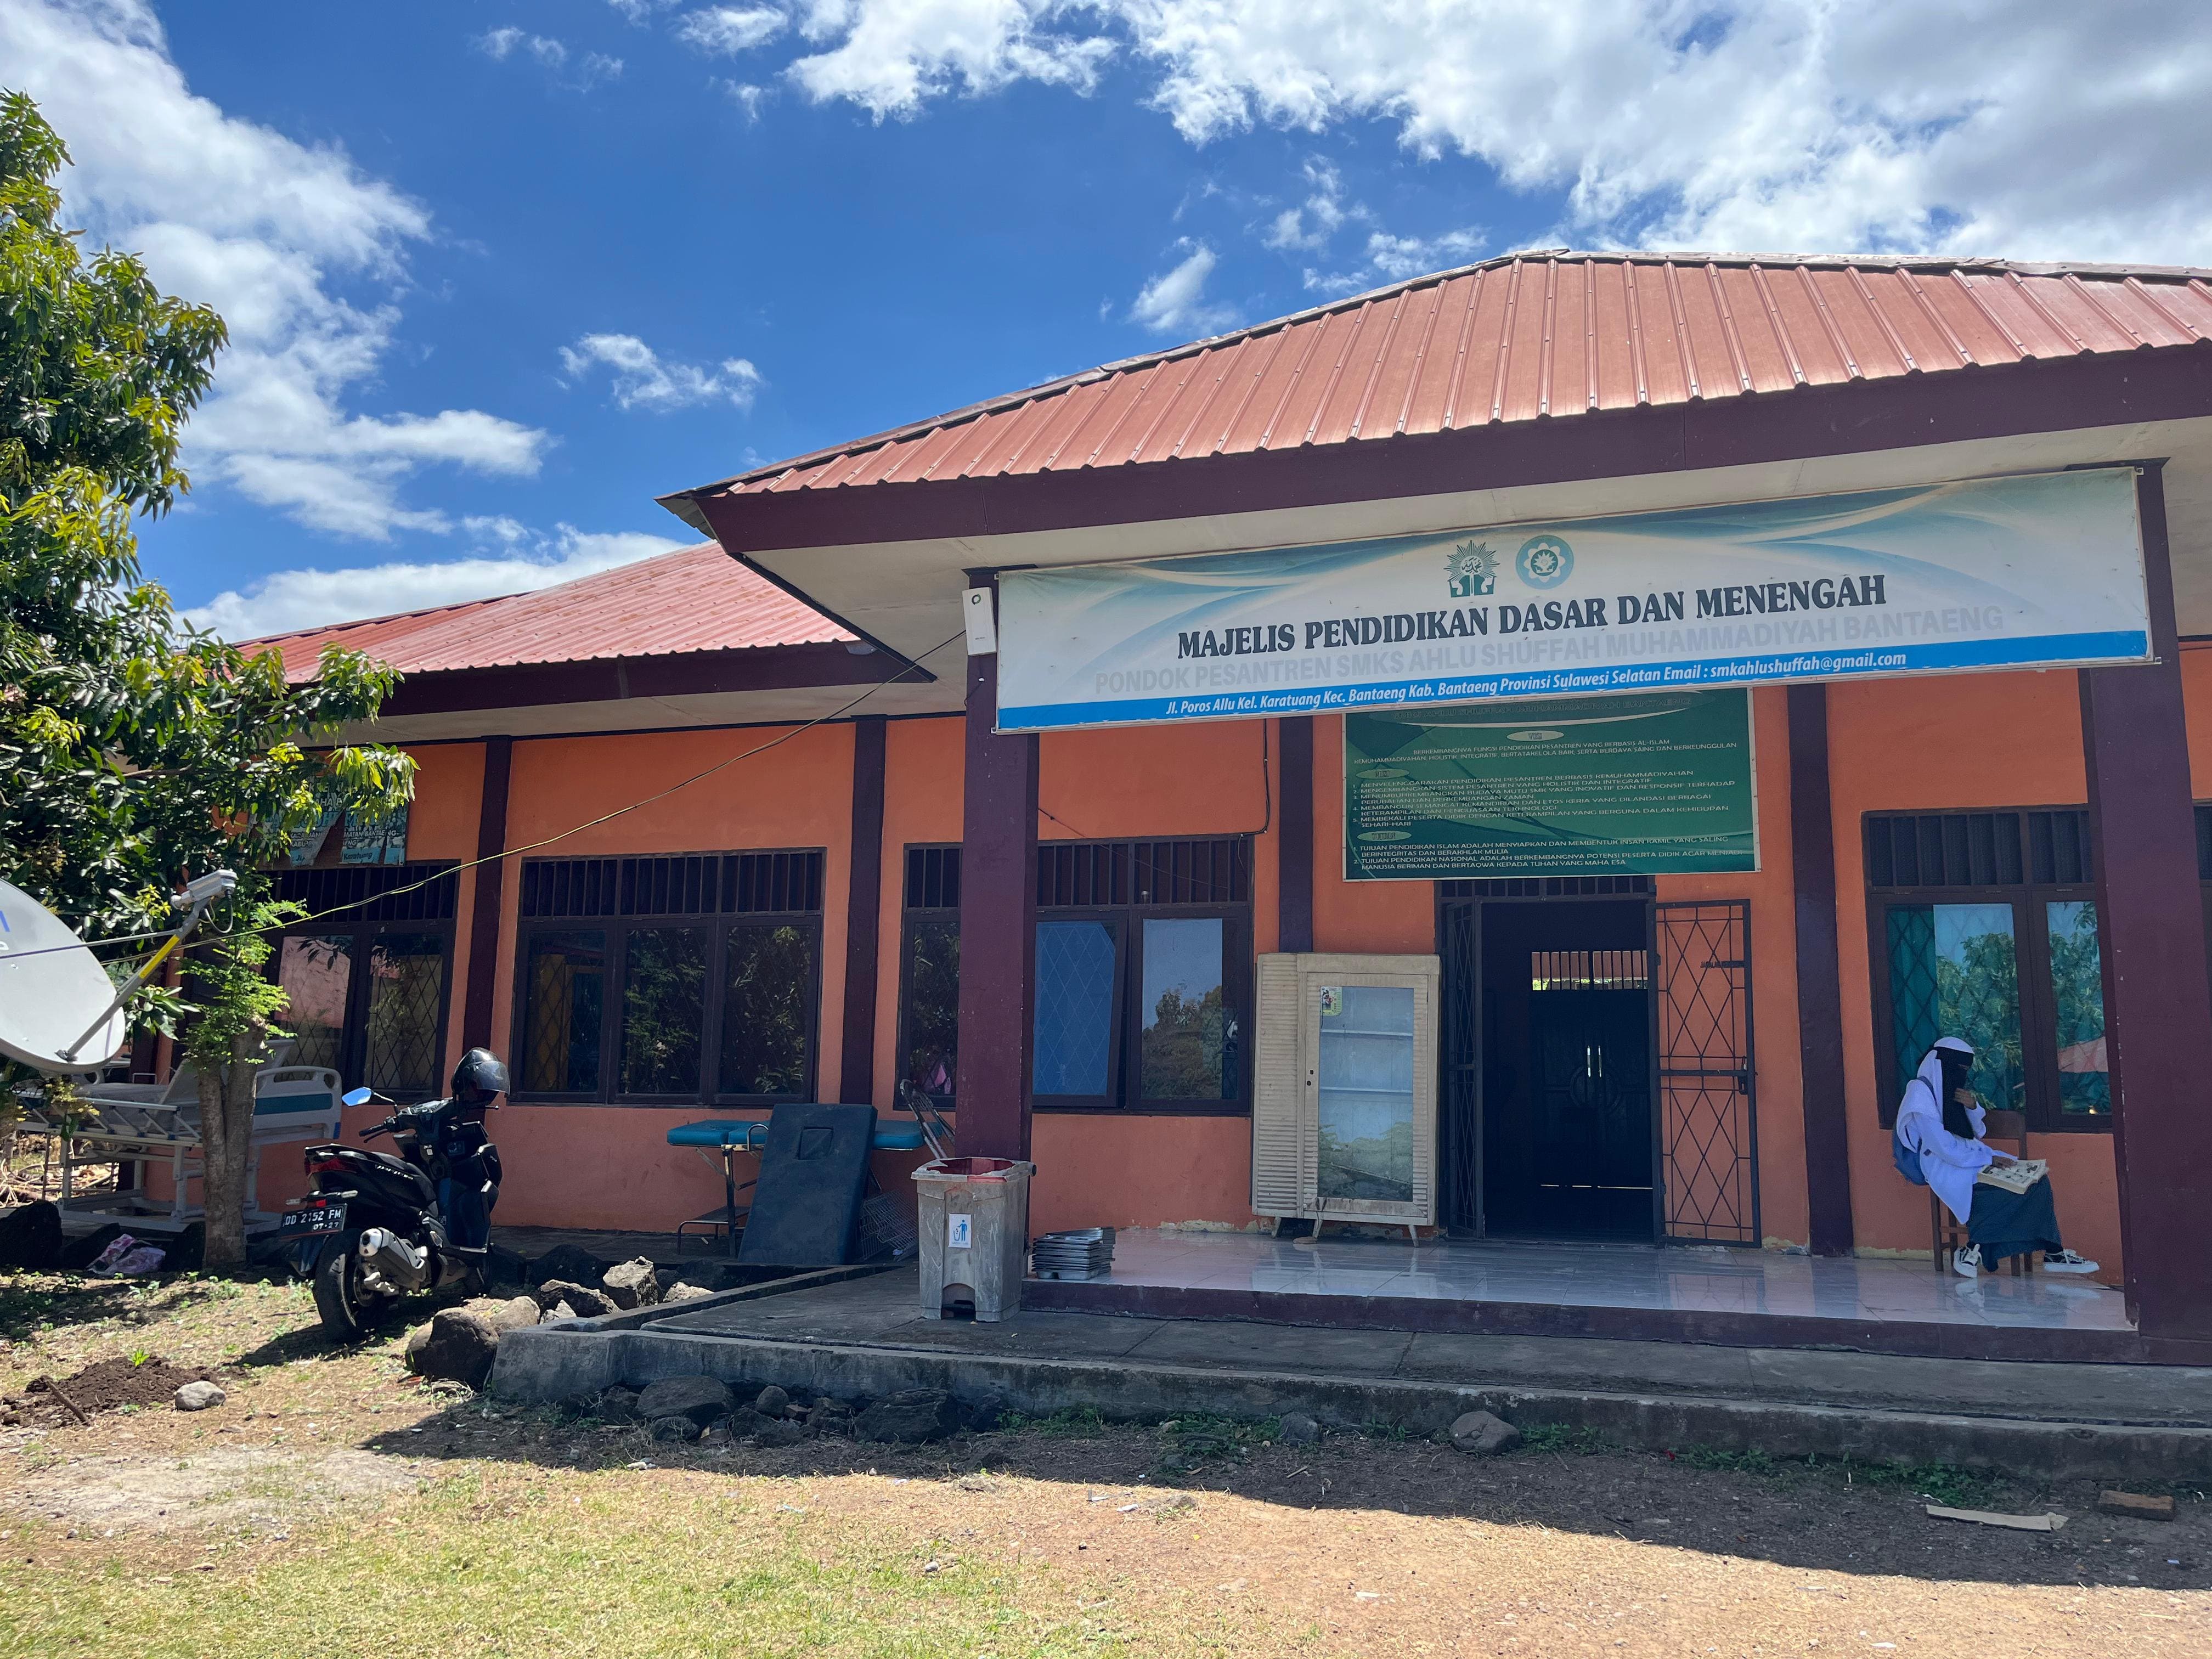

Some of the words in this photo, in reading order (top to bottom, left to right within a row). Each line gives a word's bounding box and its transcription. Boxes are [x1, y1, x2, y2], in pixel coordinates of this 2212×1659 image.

[1178, 624, 1295, 659] MAJELIS
[1305, 607, 1488, 649] PENDIDIKAN
[1499, 599, 1608, 634] DASAR
[1617, 591, 1684, 624] DAN
[1696, 575, 1886, 618] MENENGAH
[1096, 666, 1190, 693] PONDOK
[1195, 658, 1331, 687] PESANTREN
[1336, 650, 1404, 678] SMKS
[1409, 643, 1476, 672] AHLU
[1481, 635, 1600, 667] SHUFFAH
[1607, 618, 1837, 656] MUHAMMADIYAH
[1844, 606, 2004, 640] BANTAENG
[1166, 702, 1177, 714] Jl.
[1181, 699, 1210, 713] Poros
[1213, 697, 1235, 712] Allu
[1237, 696, 1257, 709] Kel.
[1261, 691, 1321, 708] Karatuang
[1323, 690, 1344, 705] Kec.
[1349, 685, 1406, 702] Bantaeng
[1409, 684, 1434, 698] Kab.
[1438, 676, 1498, 696] Bantaeng
[1501, 675, 1550, 691] Provinsi
[1553, 672, 1609, 688] Sulawesi
[1612, 669, 1661, 683] Selatan
[1664, 665, 1699, 680] Email
[1711, 652, 1906, 678] smkahlushuffah@gmail.com
[1501, 750, 1556, 758] BERTATAKELOLA
[1674, 742, 1736, 751] BERKEUNGGULAN
[301, 1211, 324, 1223] 2152
[329, 1209, 341, 1219] FM
